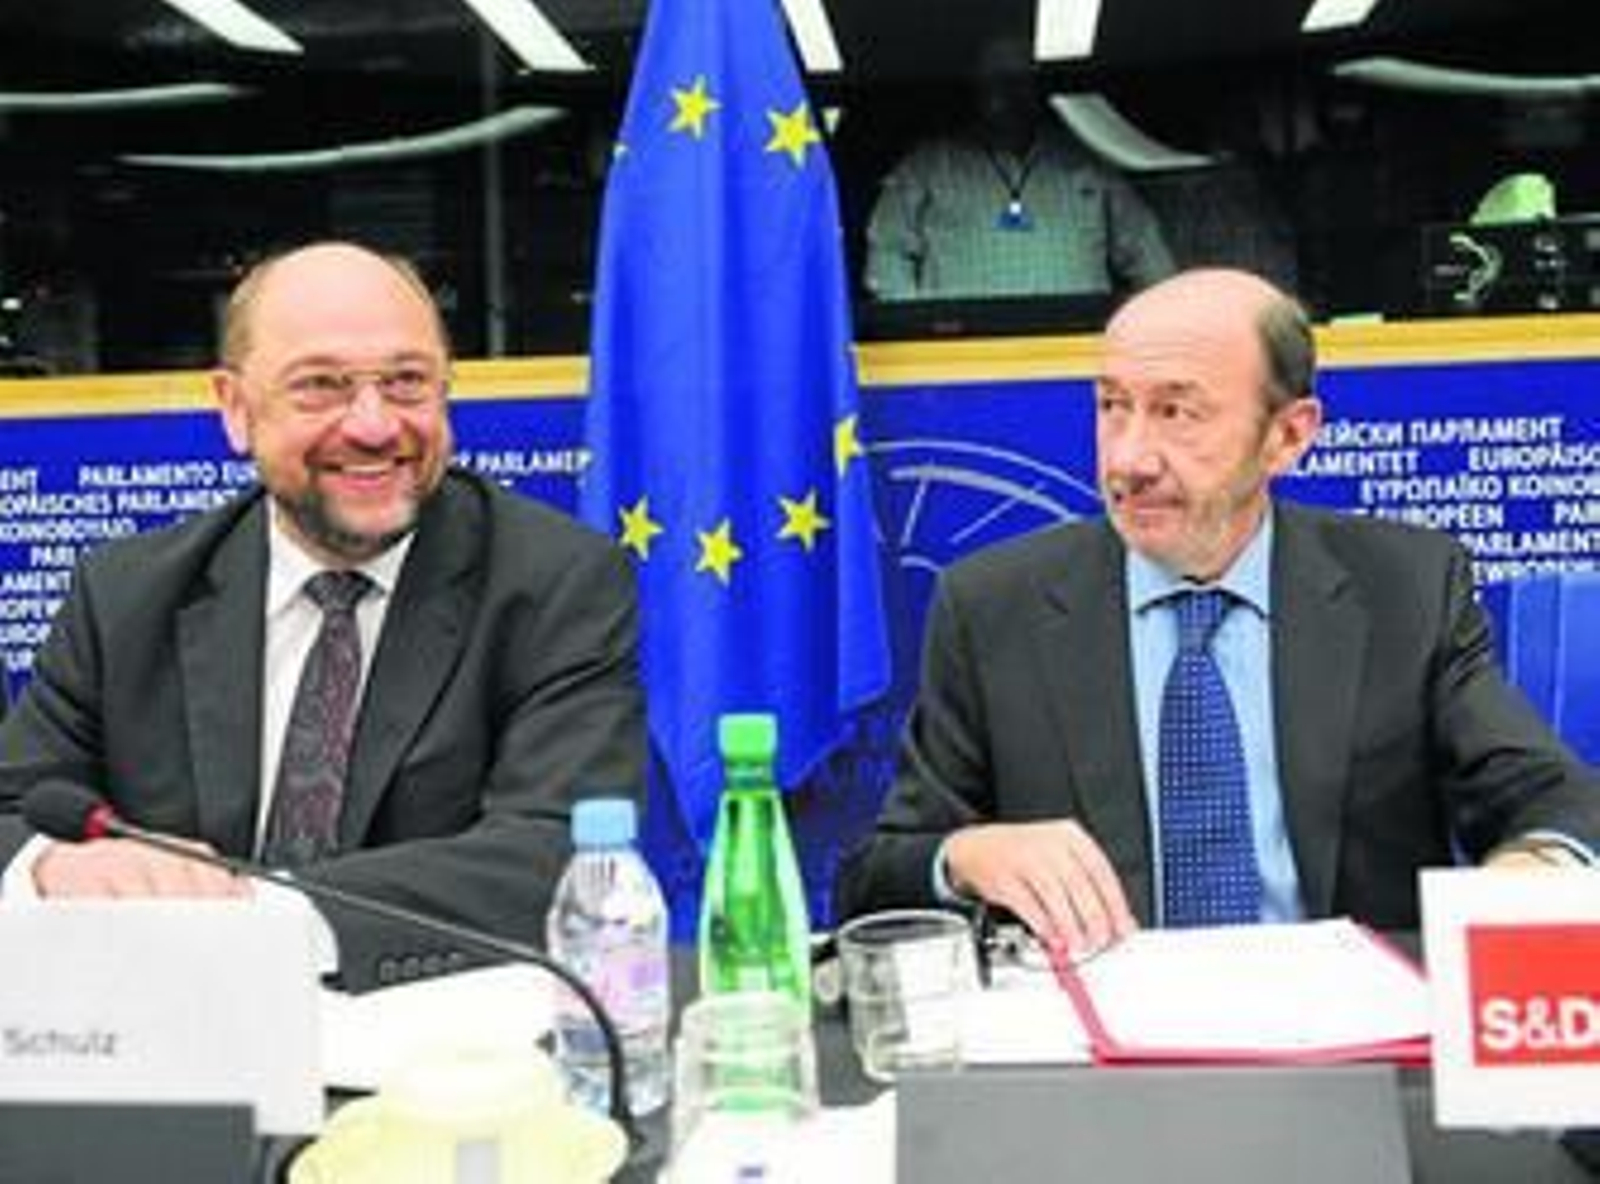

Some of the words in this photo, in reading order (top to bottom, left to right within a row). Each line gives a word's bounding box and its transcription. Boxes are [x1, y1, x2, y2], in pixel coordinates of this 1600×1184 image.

[1410, 415, 1563, 443] ПАРЛАМЕНТ
[78, 463, 217, 488] PARLAMENTO
[1480, 997, 1600, 1050] S&D
[3, 1027, 117, 1056] Schulz
